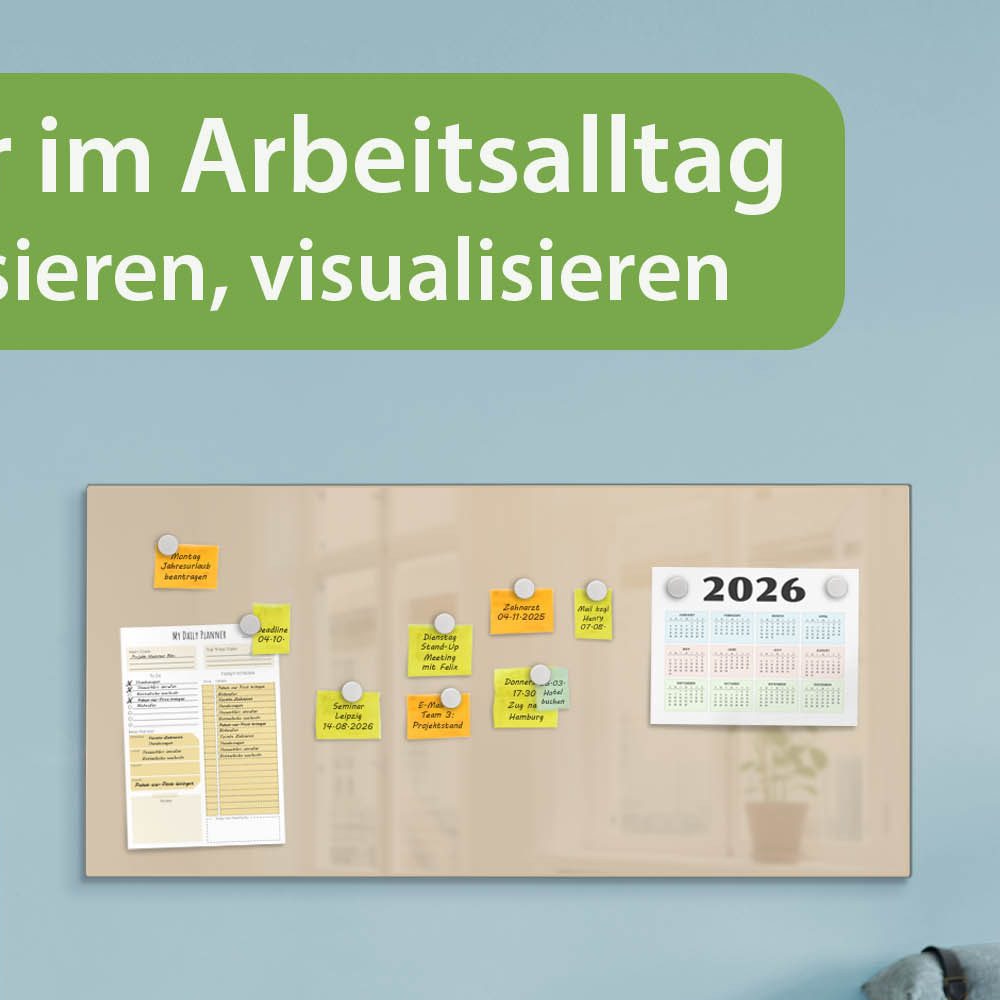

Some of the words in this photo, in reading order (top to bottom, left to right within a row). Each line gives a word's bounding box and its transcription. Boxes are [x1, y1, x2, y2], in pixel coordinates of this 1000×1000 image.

[170, 552, 201, 561] Montag
[160, 562, 211, 570] Jahresurlaub
[164, 573, 208, 582] beantragen
[703, 576, 806, 603] 2026
[423, 634, 457, 642] Dienstag
[421, 643, 459, 652] Stand-Up
[424, 654, 456, 662] Meeting
[507, 702, 524, 710] Zug
[335, 712, 362, 720] Leipzig
[421, 711, 442, 719] Team
[509, 713, 544, 722] Hamburg
[412, 721, 464, 731] Projektstand
